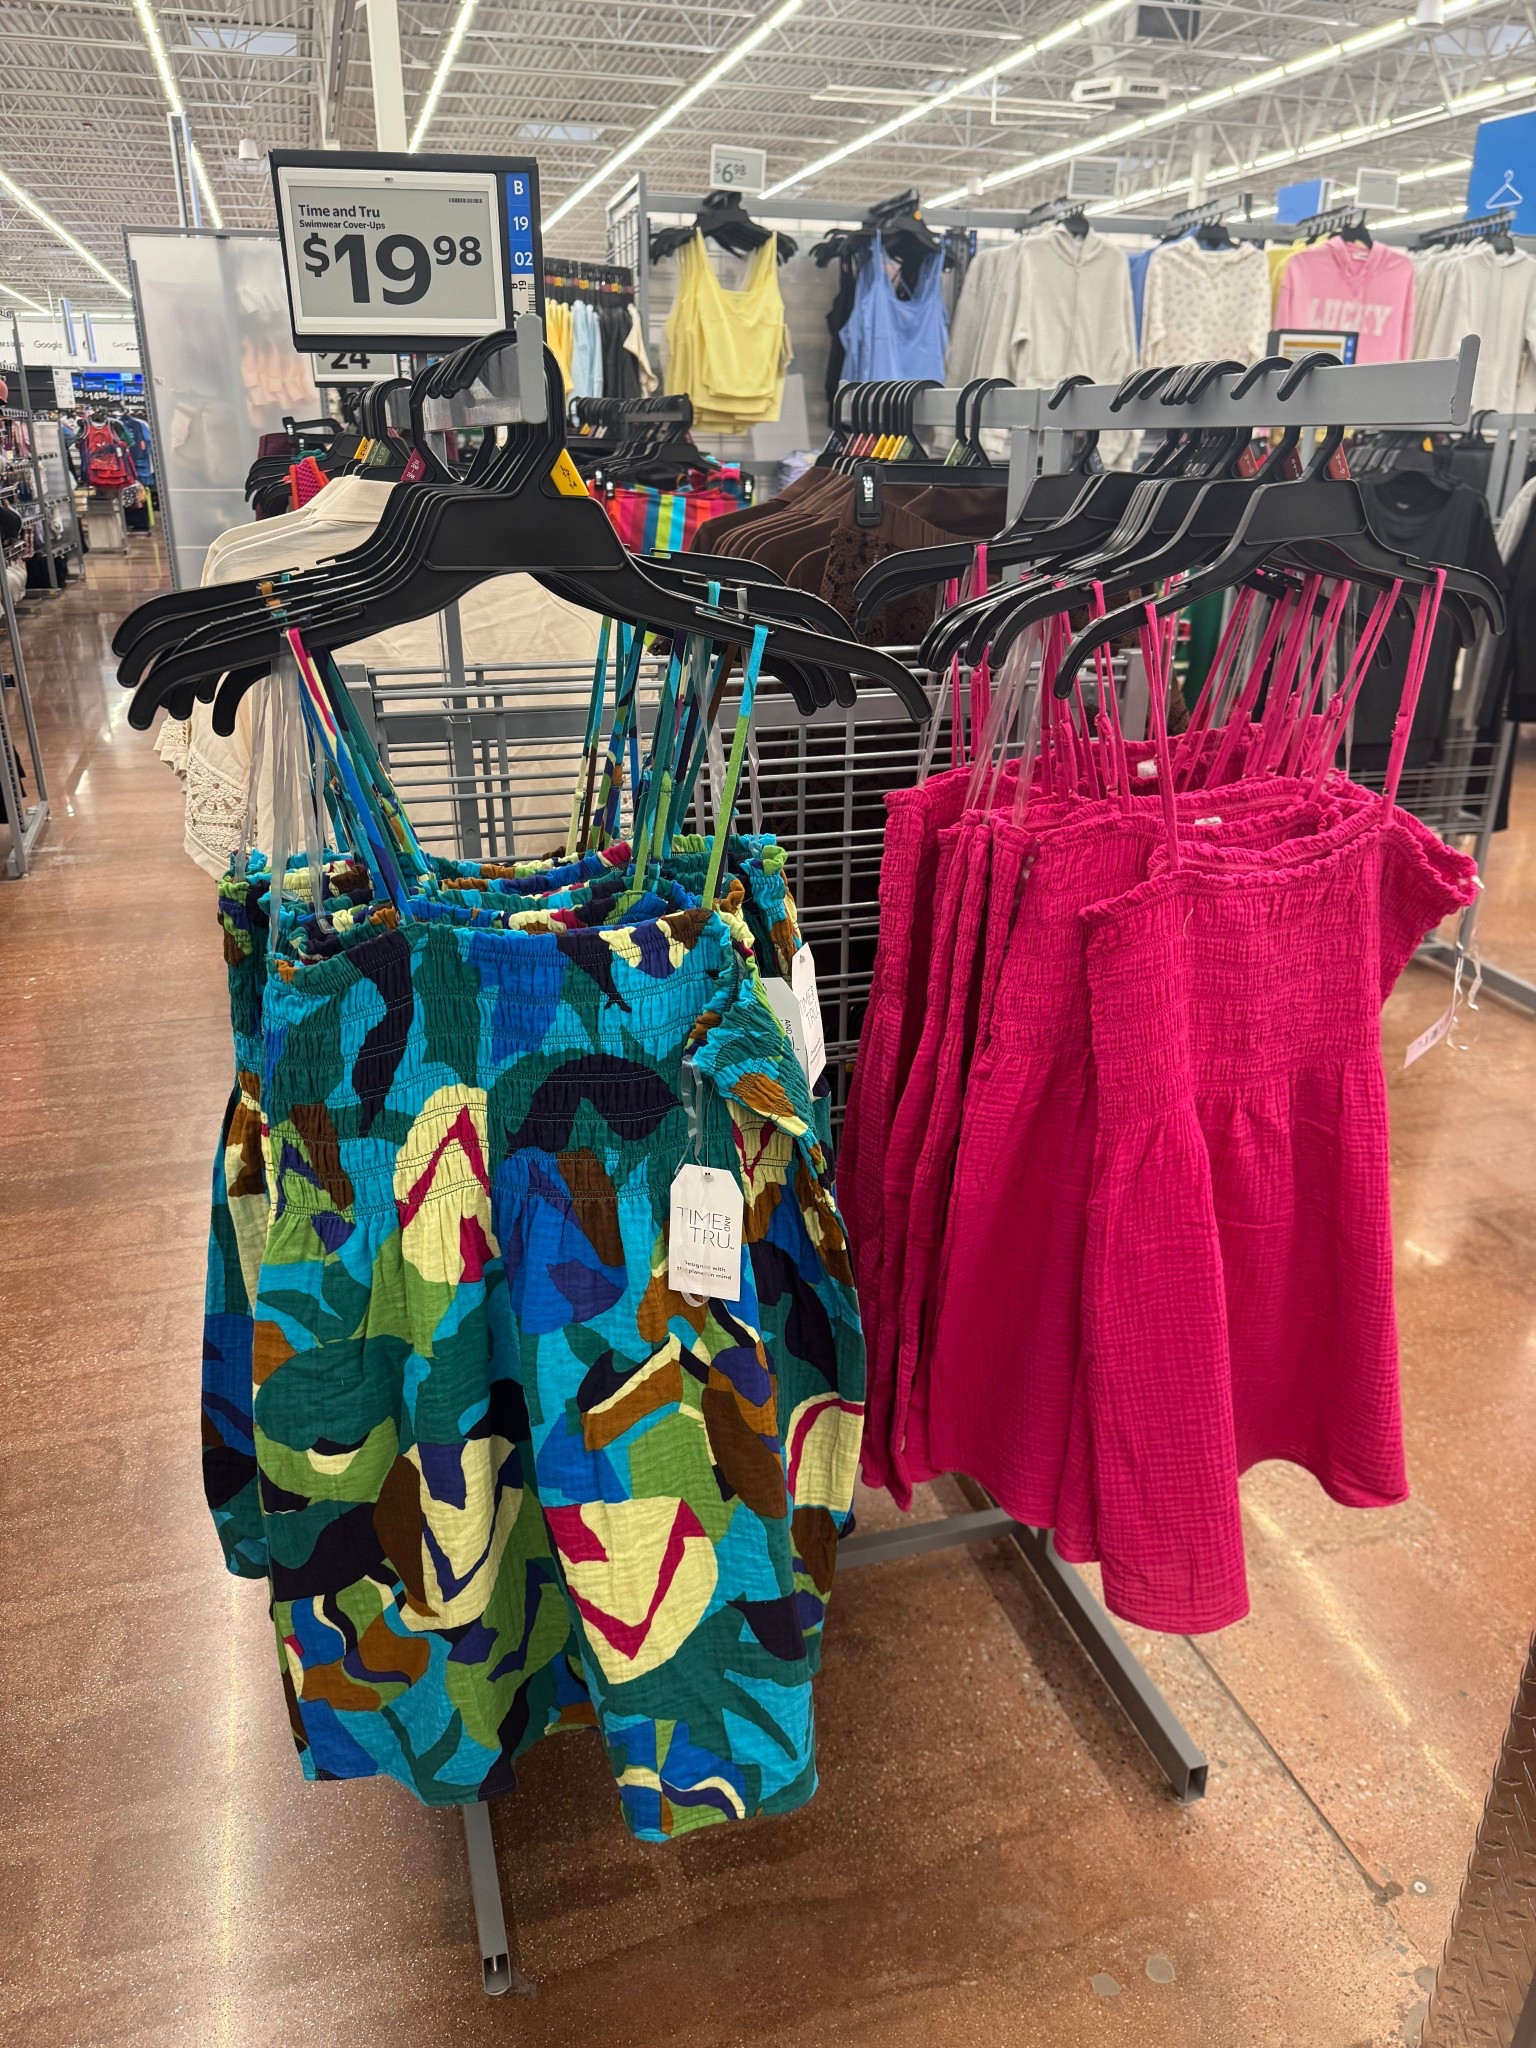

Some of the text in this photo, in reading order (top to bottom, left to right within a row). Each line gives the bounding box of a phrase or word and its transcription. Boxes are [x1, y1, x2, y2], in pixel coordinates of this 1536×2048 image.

[513, 180, 524, 195] B
[298, 204, 380, 218] Time and Tru
[299, 219, 386, 231] Swimwear Cover-Ups
[513, 216, 529, 231] 19
[514, 251, 533, 266] 02
[1311, 298, 1392, 336] LUCKY
[33, 340, 62, 350] Google
[784, 1019, 793, 1035] AND
[676, 1206, 723, 1231] TIME
[724, 1215, 732, 1232] AND
